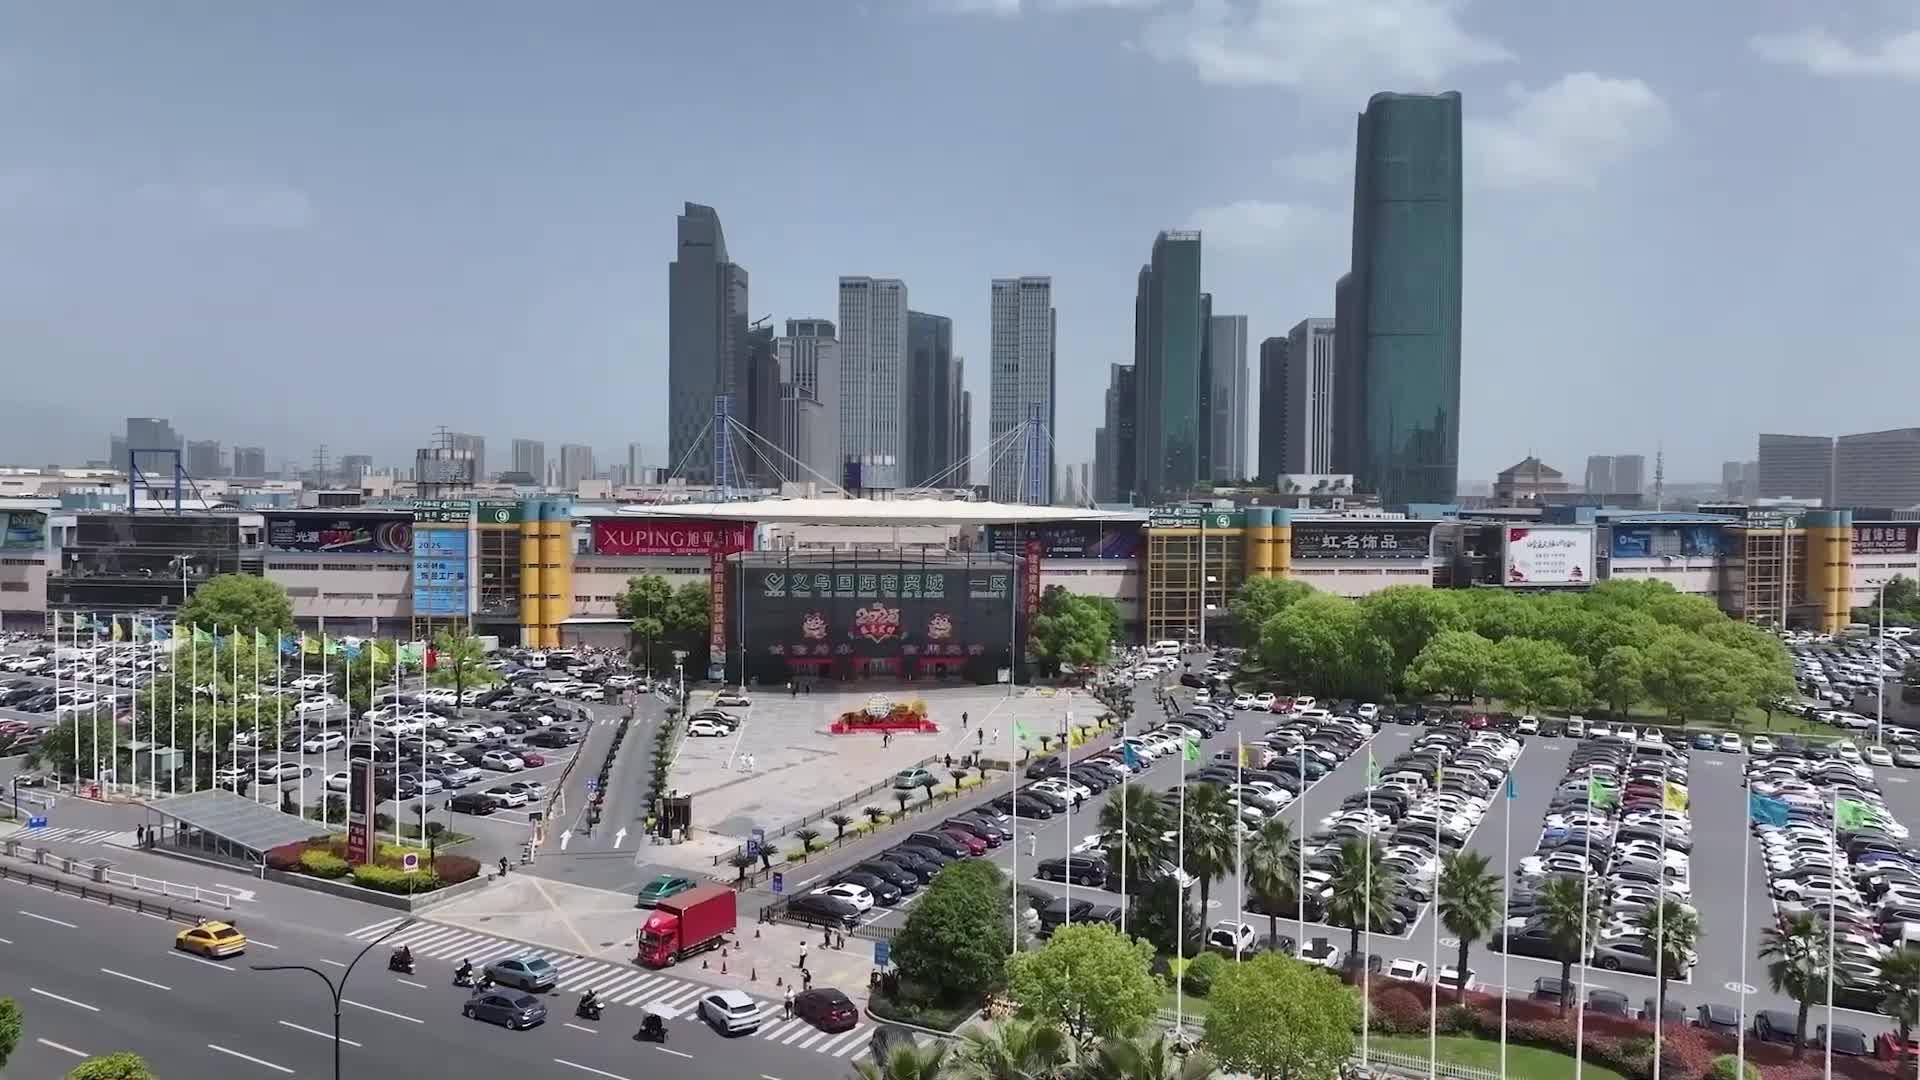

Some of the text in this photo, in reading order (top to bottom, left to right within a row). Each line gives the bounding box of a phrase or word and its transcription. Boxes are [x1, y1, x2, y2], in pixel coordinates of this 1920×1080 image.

[604, 530, 684, 547] XUPING
[1321, 534, 1398, 549] 虹名饰品
[792, 573, 1007, 591] 义乌国际商贸城 一区
